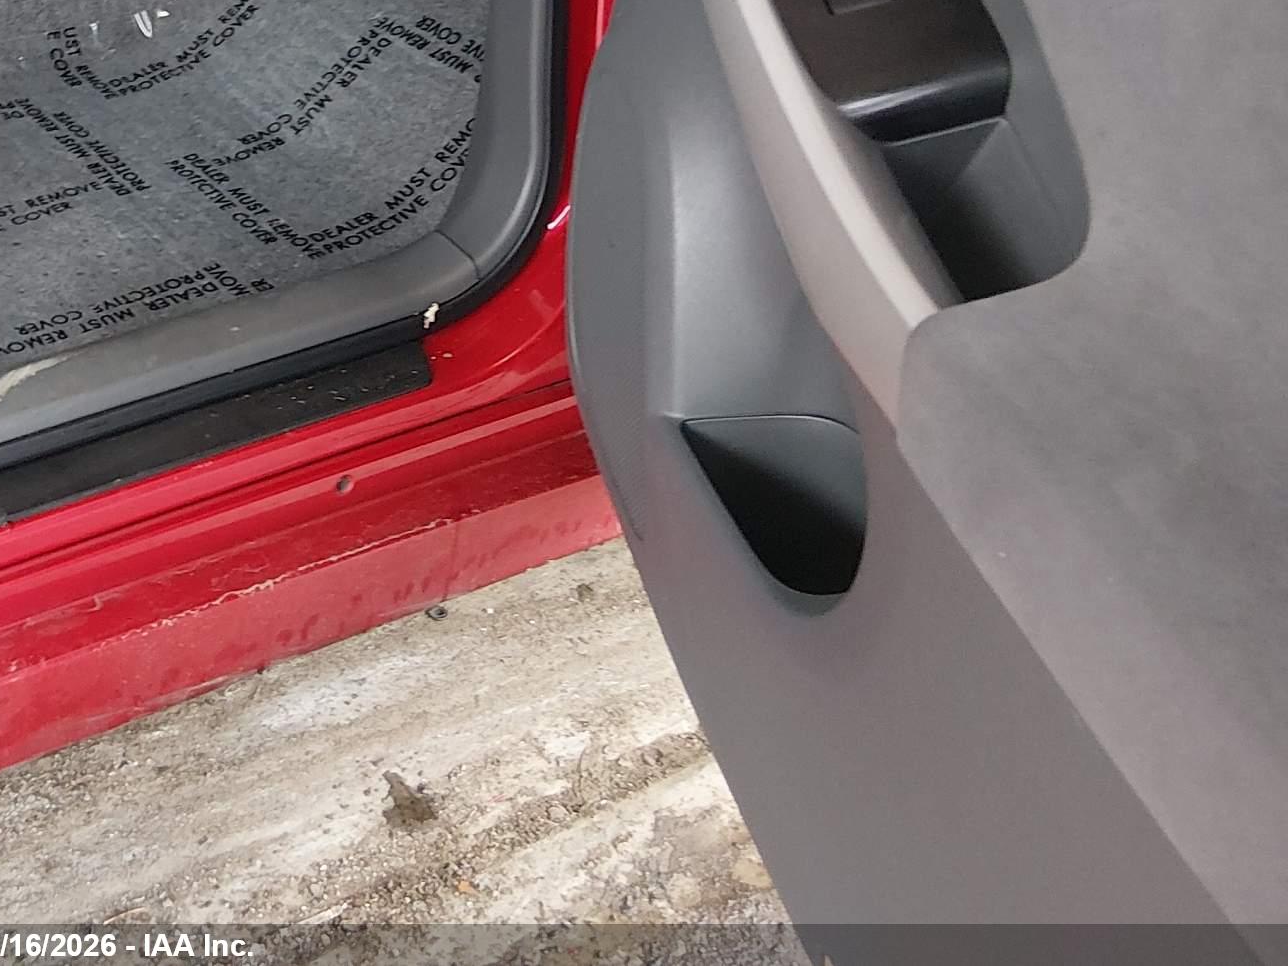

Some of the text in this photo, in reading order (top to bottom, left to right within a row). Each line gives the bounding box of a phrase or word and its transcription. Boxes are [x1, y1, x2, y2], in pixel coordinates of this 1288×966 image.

[119, 4, 260, 96] PROTECTIVE COVER
[176, 28, 215, 63] MUST
[372, 17, 474, 74] MUST REMOVE
[415, 15, 462, 45] COVER
[336, 37, 392, 88] DEALER
[236, 29, 379, 146] PROTECTIVE COVER
[290, 94, 333, 135] MUST
[11, 201, 73, 226] COVER
[25, 181, 105, 208] REMOVE
[227, 187, 271, 216] MUST
[309, 211, 380, 243] DEALER
[384, 167, 432, 210] MUST
[323, 194, 430, 254] PROTECTIVE
[14, 270, 206, 336] PROTECTIVE COVER
[145, 281, 219, 312] DEALER
[79, 308, 135, 334] MUST
